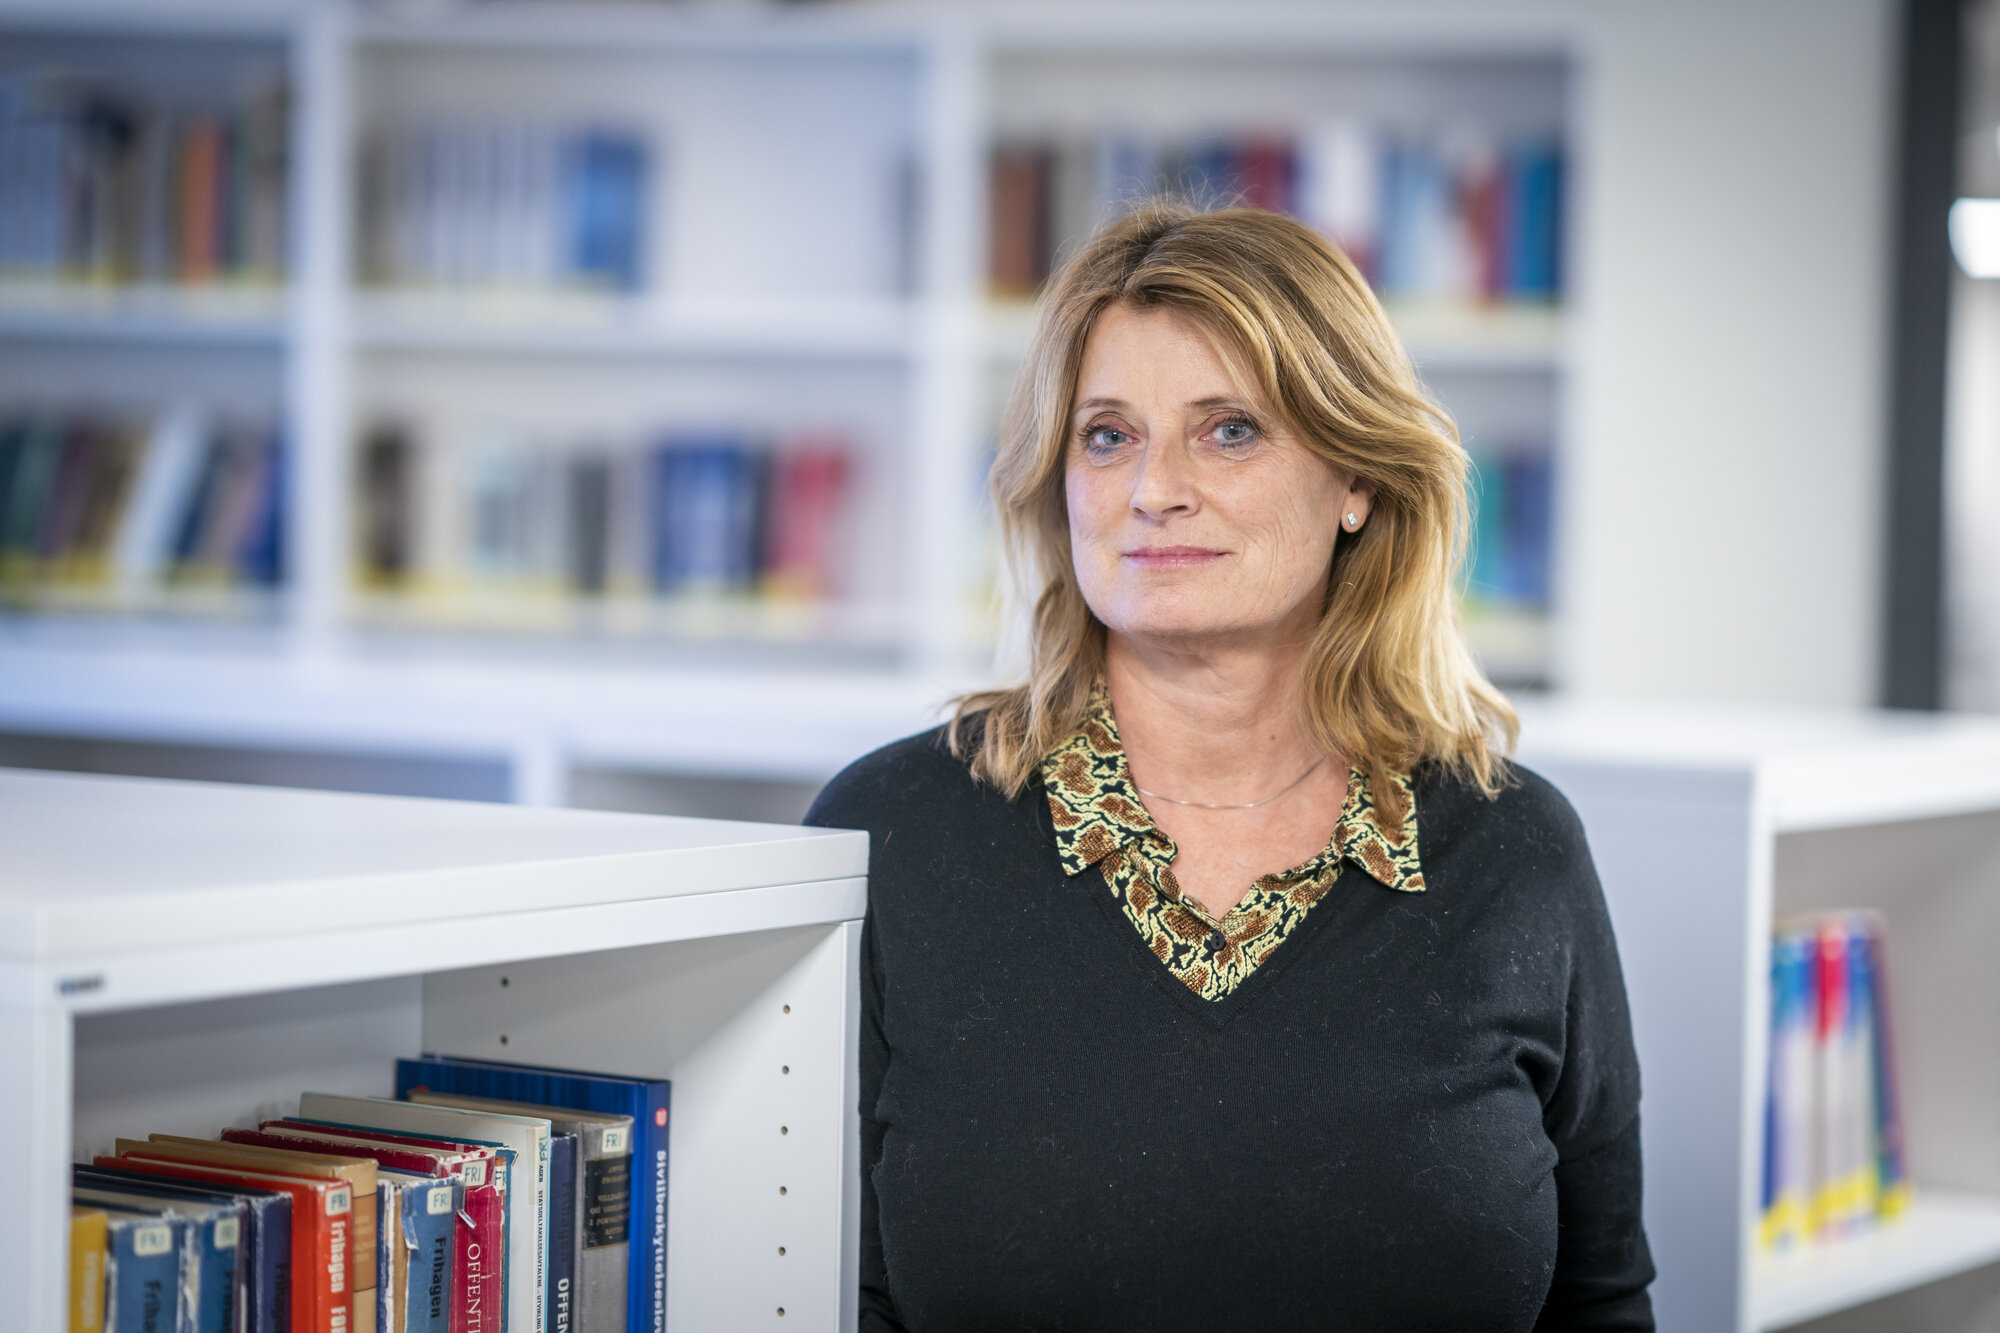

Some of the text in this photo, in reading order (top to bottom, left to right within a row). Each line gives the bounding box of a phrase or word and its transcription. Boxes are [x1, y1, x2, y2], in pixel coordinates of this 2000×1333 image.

[605, 1133, 622, 1149] FRI
[464, 1167, 481, 1183] FRI
[328, 1221, 346, 1293] Frihagen
[429, 1237, 447, 1318] Frihagen
